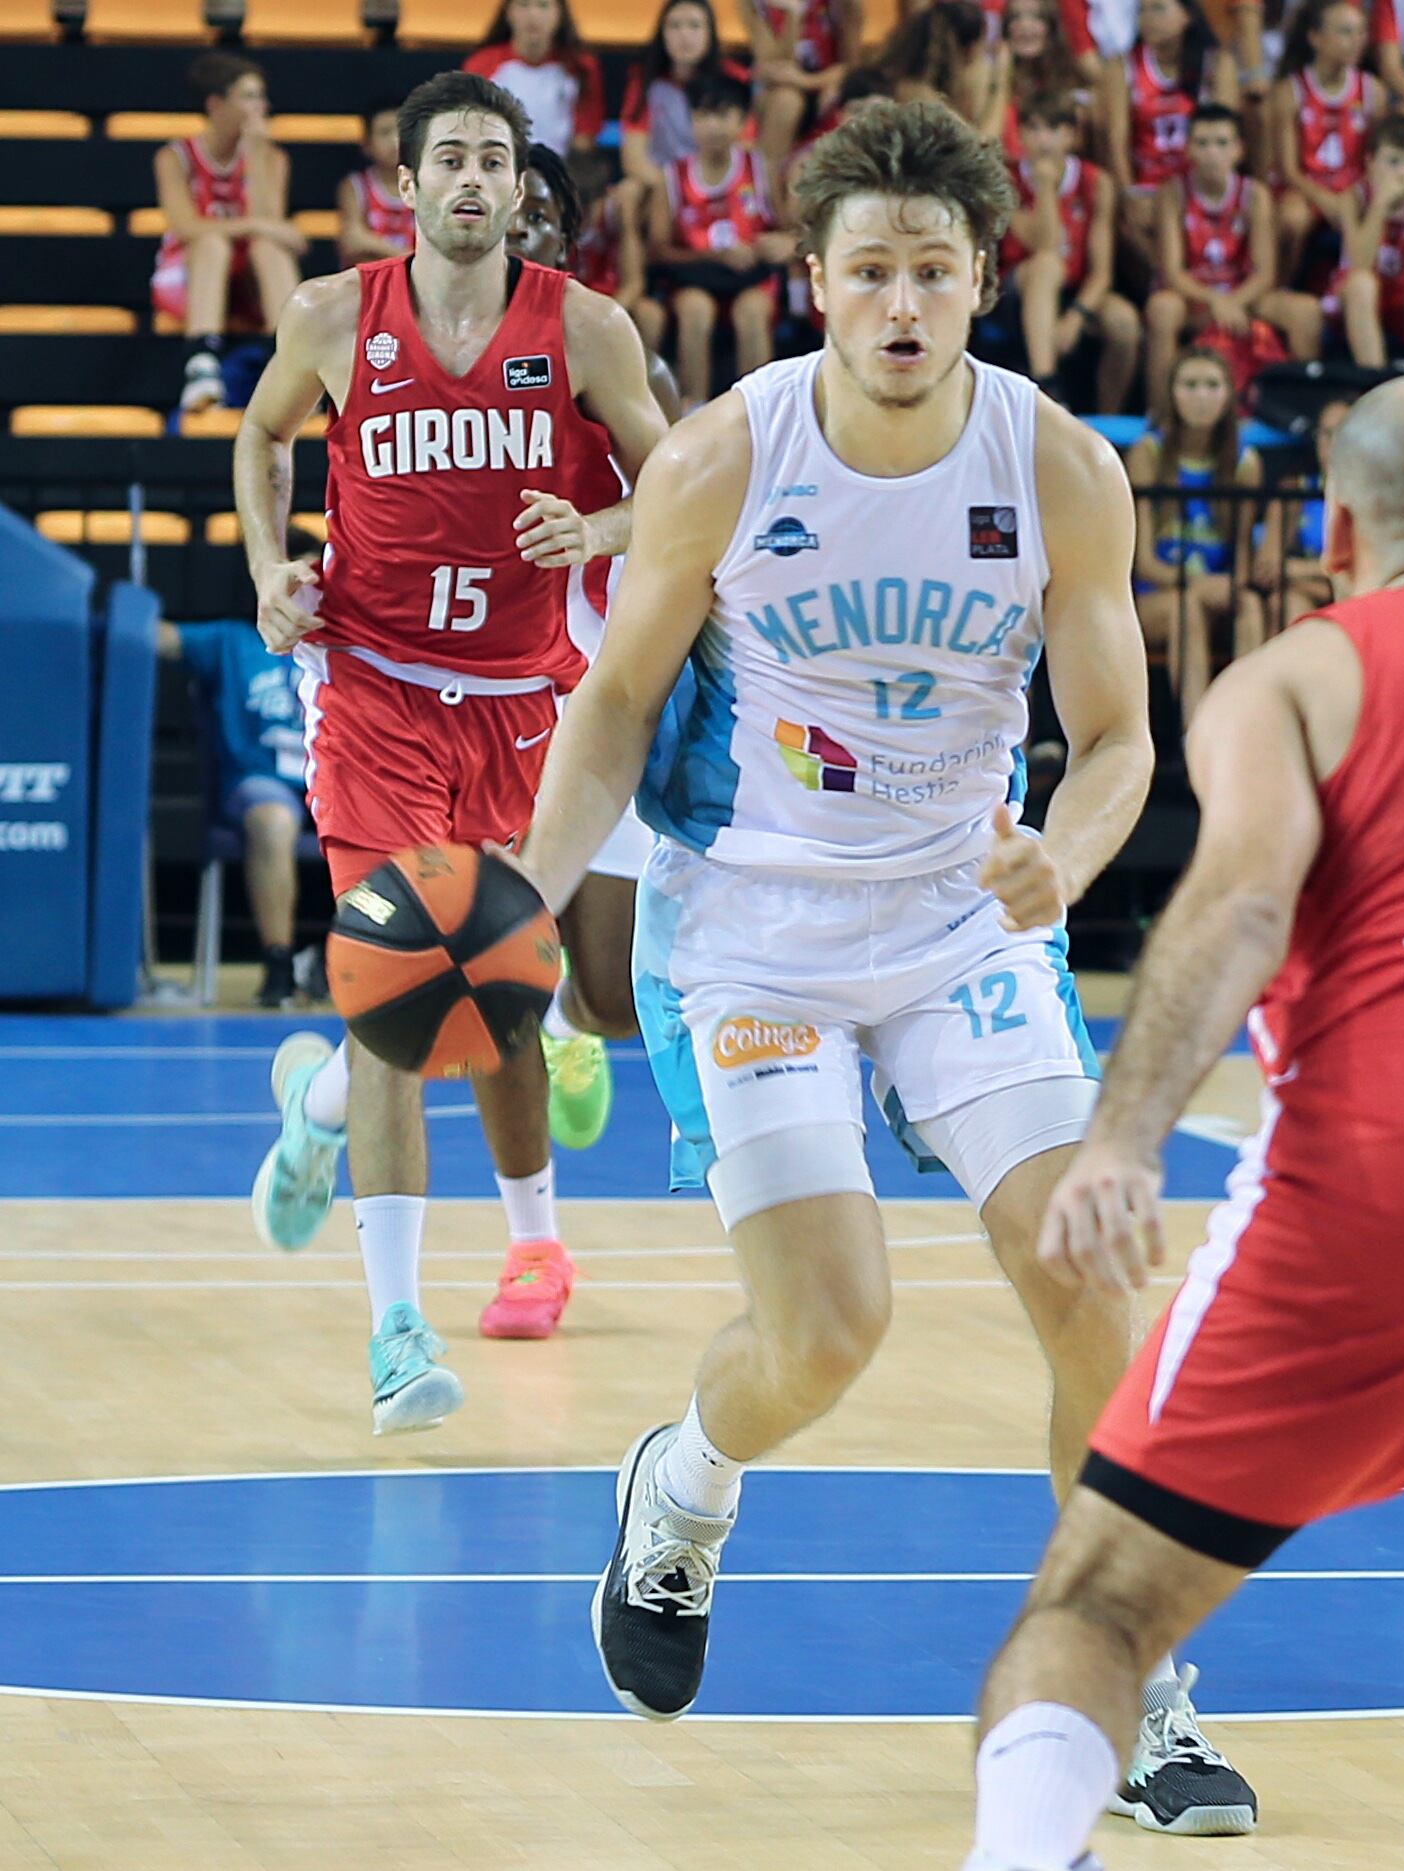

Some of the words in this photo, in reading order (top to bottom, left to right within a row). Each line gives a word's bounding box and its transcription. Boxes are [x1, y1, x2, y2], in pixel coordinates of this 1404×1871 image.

[359, 408, 554, 479] GIRONA
[428, 564, 493, 632] 15
[744, 576, 1026, 665] MENORCA
[866, 670, 942, 720] 12
[948, 970, 1029, 1040] 12
